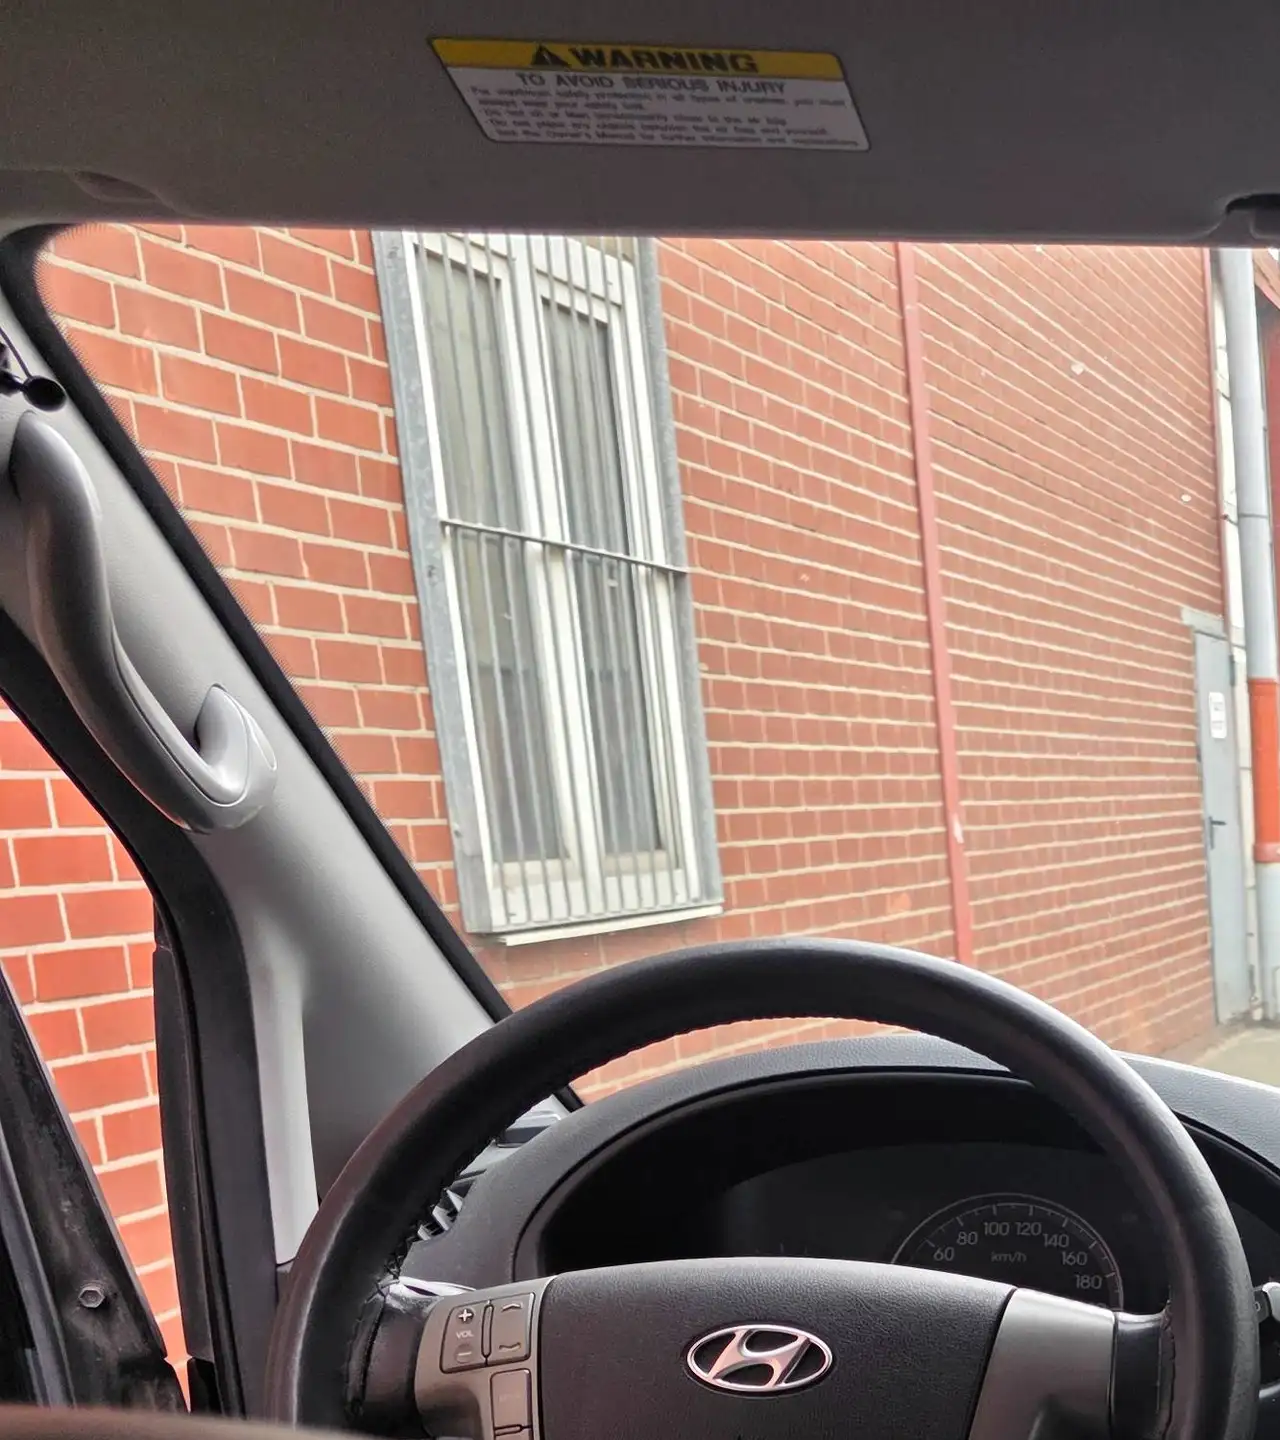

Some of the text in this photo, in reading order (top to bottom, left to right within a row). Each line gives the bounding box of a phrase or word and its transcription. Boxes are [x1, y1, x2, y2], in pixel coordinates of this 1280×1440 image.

[568, 47, 759, 73] WARNING
[516, 73, 787, 95] TO AVOID SERIOUS INJURY
[984, 1221, 1042, 1237] 100 120
[956, 1231, 978, 1246] 80
[1043, 1233, 1070, 1248] 140
[933, 1246, 955, 1262] 60
[991, 1251, 1027, 1263] km/h
[1062, 1251, 1088, 1266] 160
[1075, 1273, 1102, 1289] 180
[456, 1330, 474, 1339] VOL
